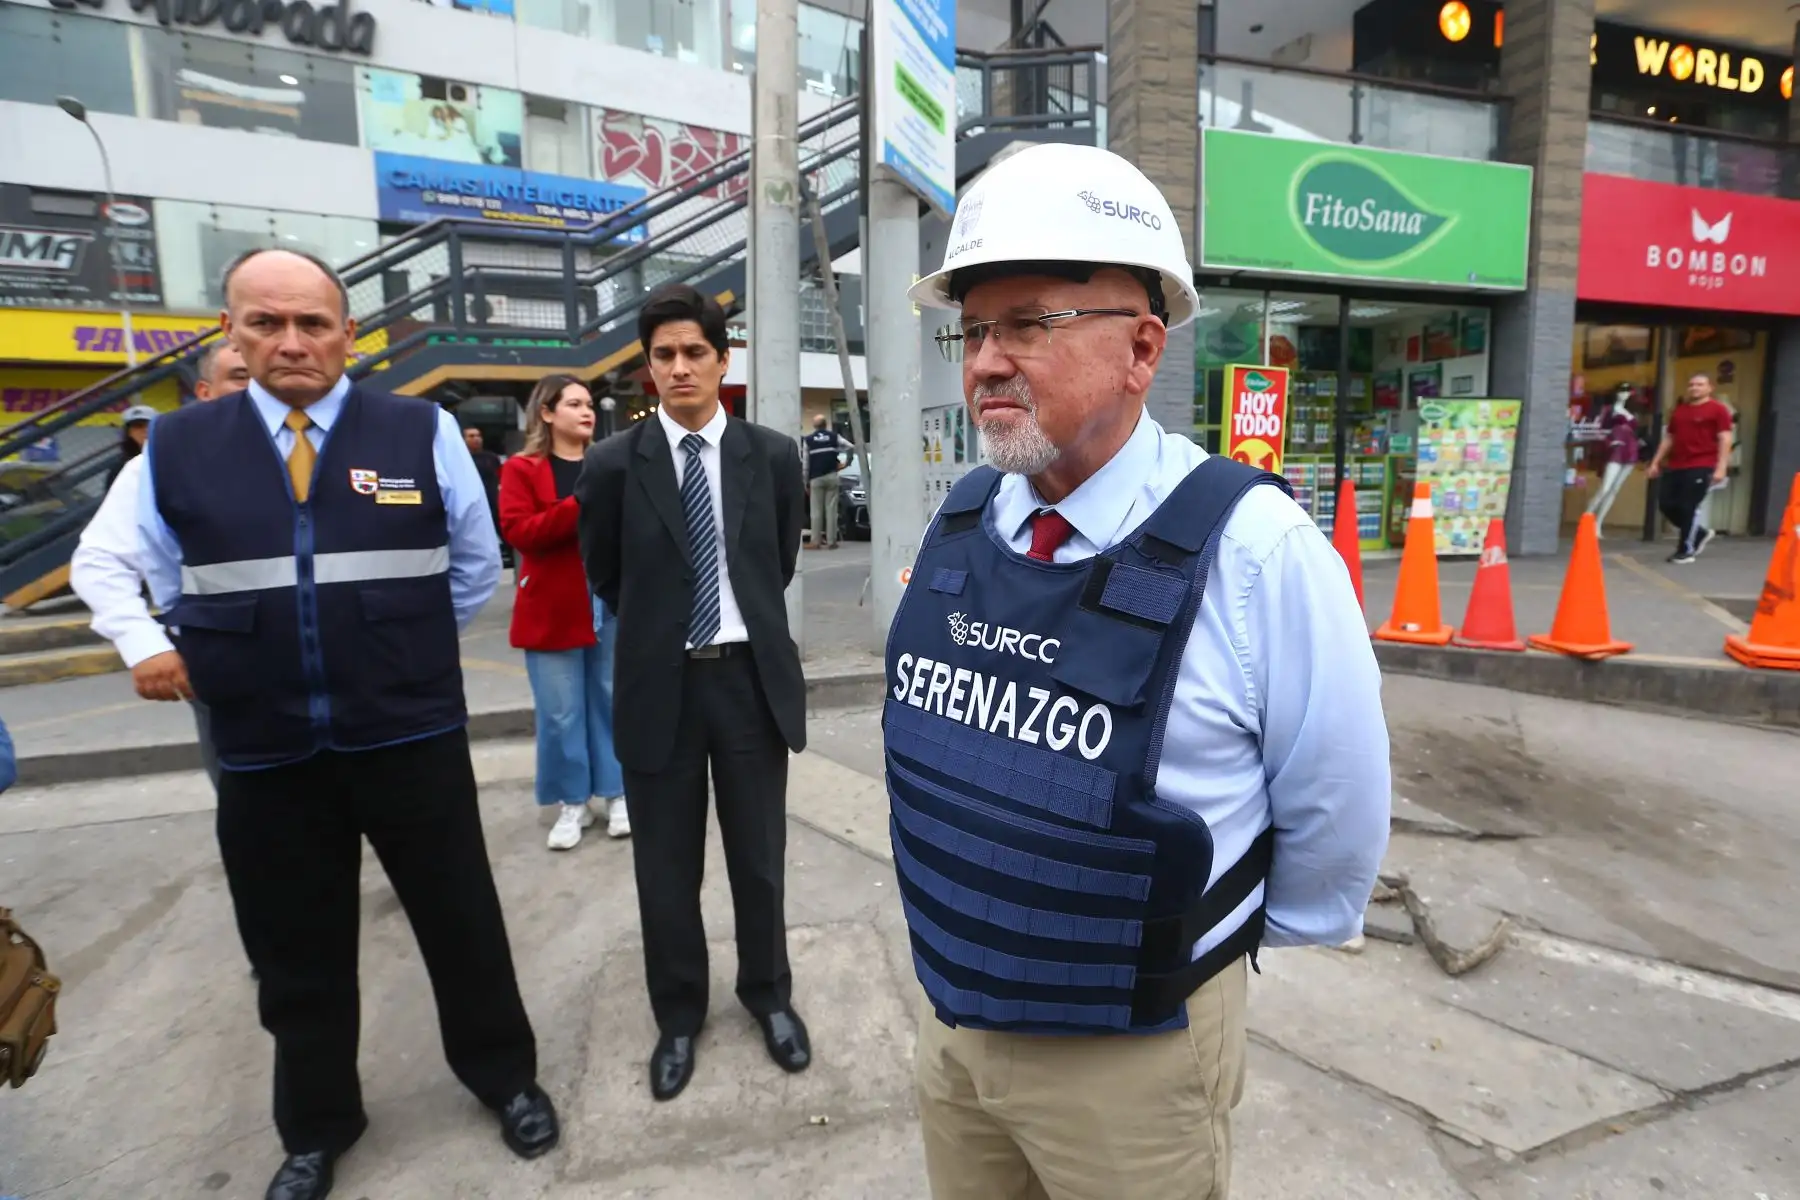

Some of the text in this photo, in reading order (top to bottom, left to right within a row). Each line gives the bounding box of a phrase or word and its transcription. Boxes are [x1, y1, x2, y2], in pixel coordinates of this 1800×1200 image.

[390, 170, 477, 196] CAMAS
[485, 181, 642, 216] INTELIGENTE
[1103, 200, 1162, 231] SURCO
[1304, 191, 1423, 235] FitoSana
[949, 238, 983, 259] ALCALDE
[1646, 244, 1766, 277] BOMBON
[1240, 391, 1278, 415] HOY
[1234, 413, 1281, 437] TODO
[893, 652, 1113, 760] SERENAZGO
